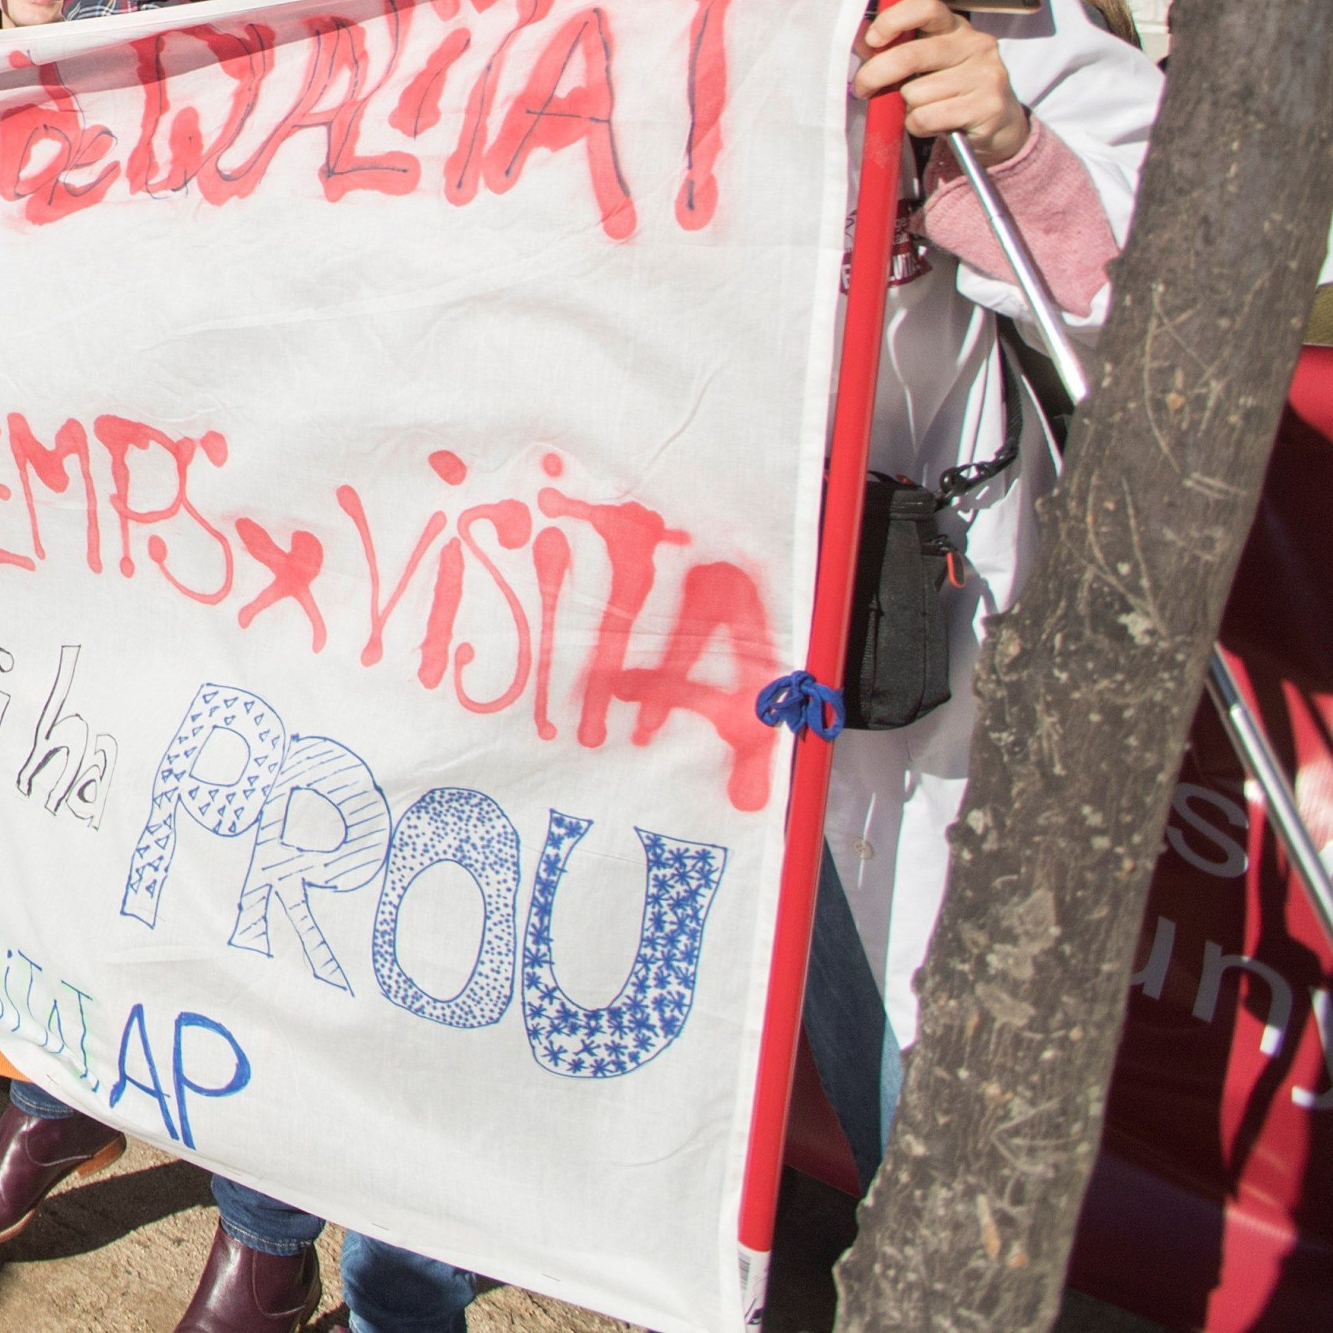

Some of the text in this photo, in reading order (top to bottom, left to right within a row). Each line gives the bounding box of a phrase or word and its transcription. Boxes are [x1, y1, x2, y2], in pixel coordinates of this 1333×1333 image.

[16, 644, 119, 830] ha
[119, 682, 730, 1080] PROU
[109, 1002, 252, 1151] AP
